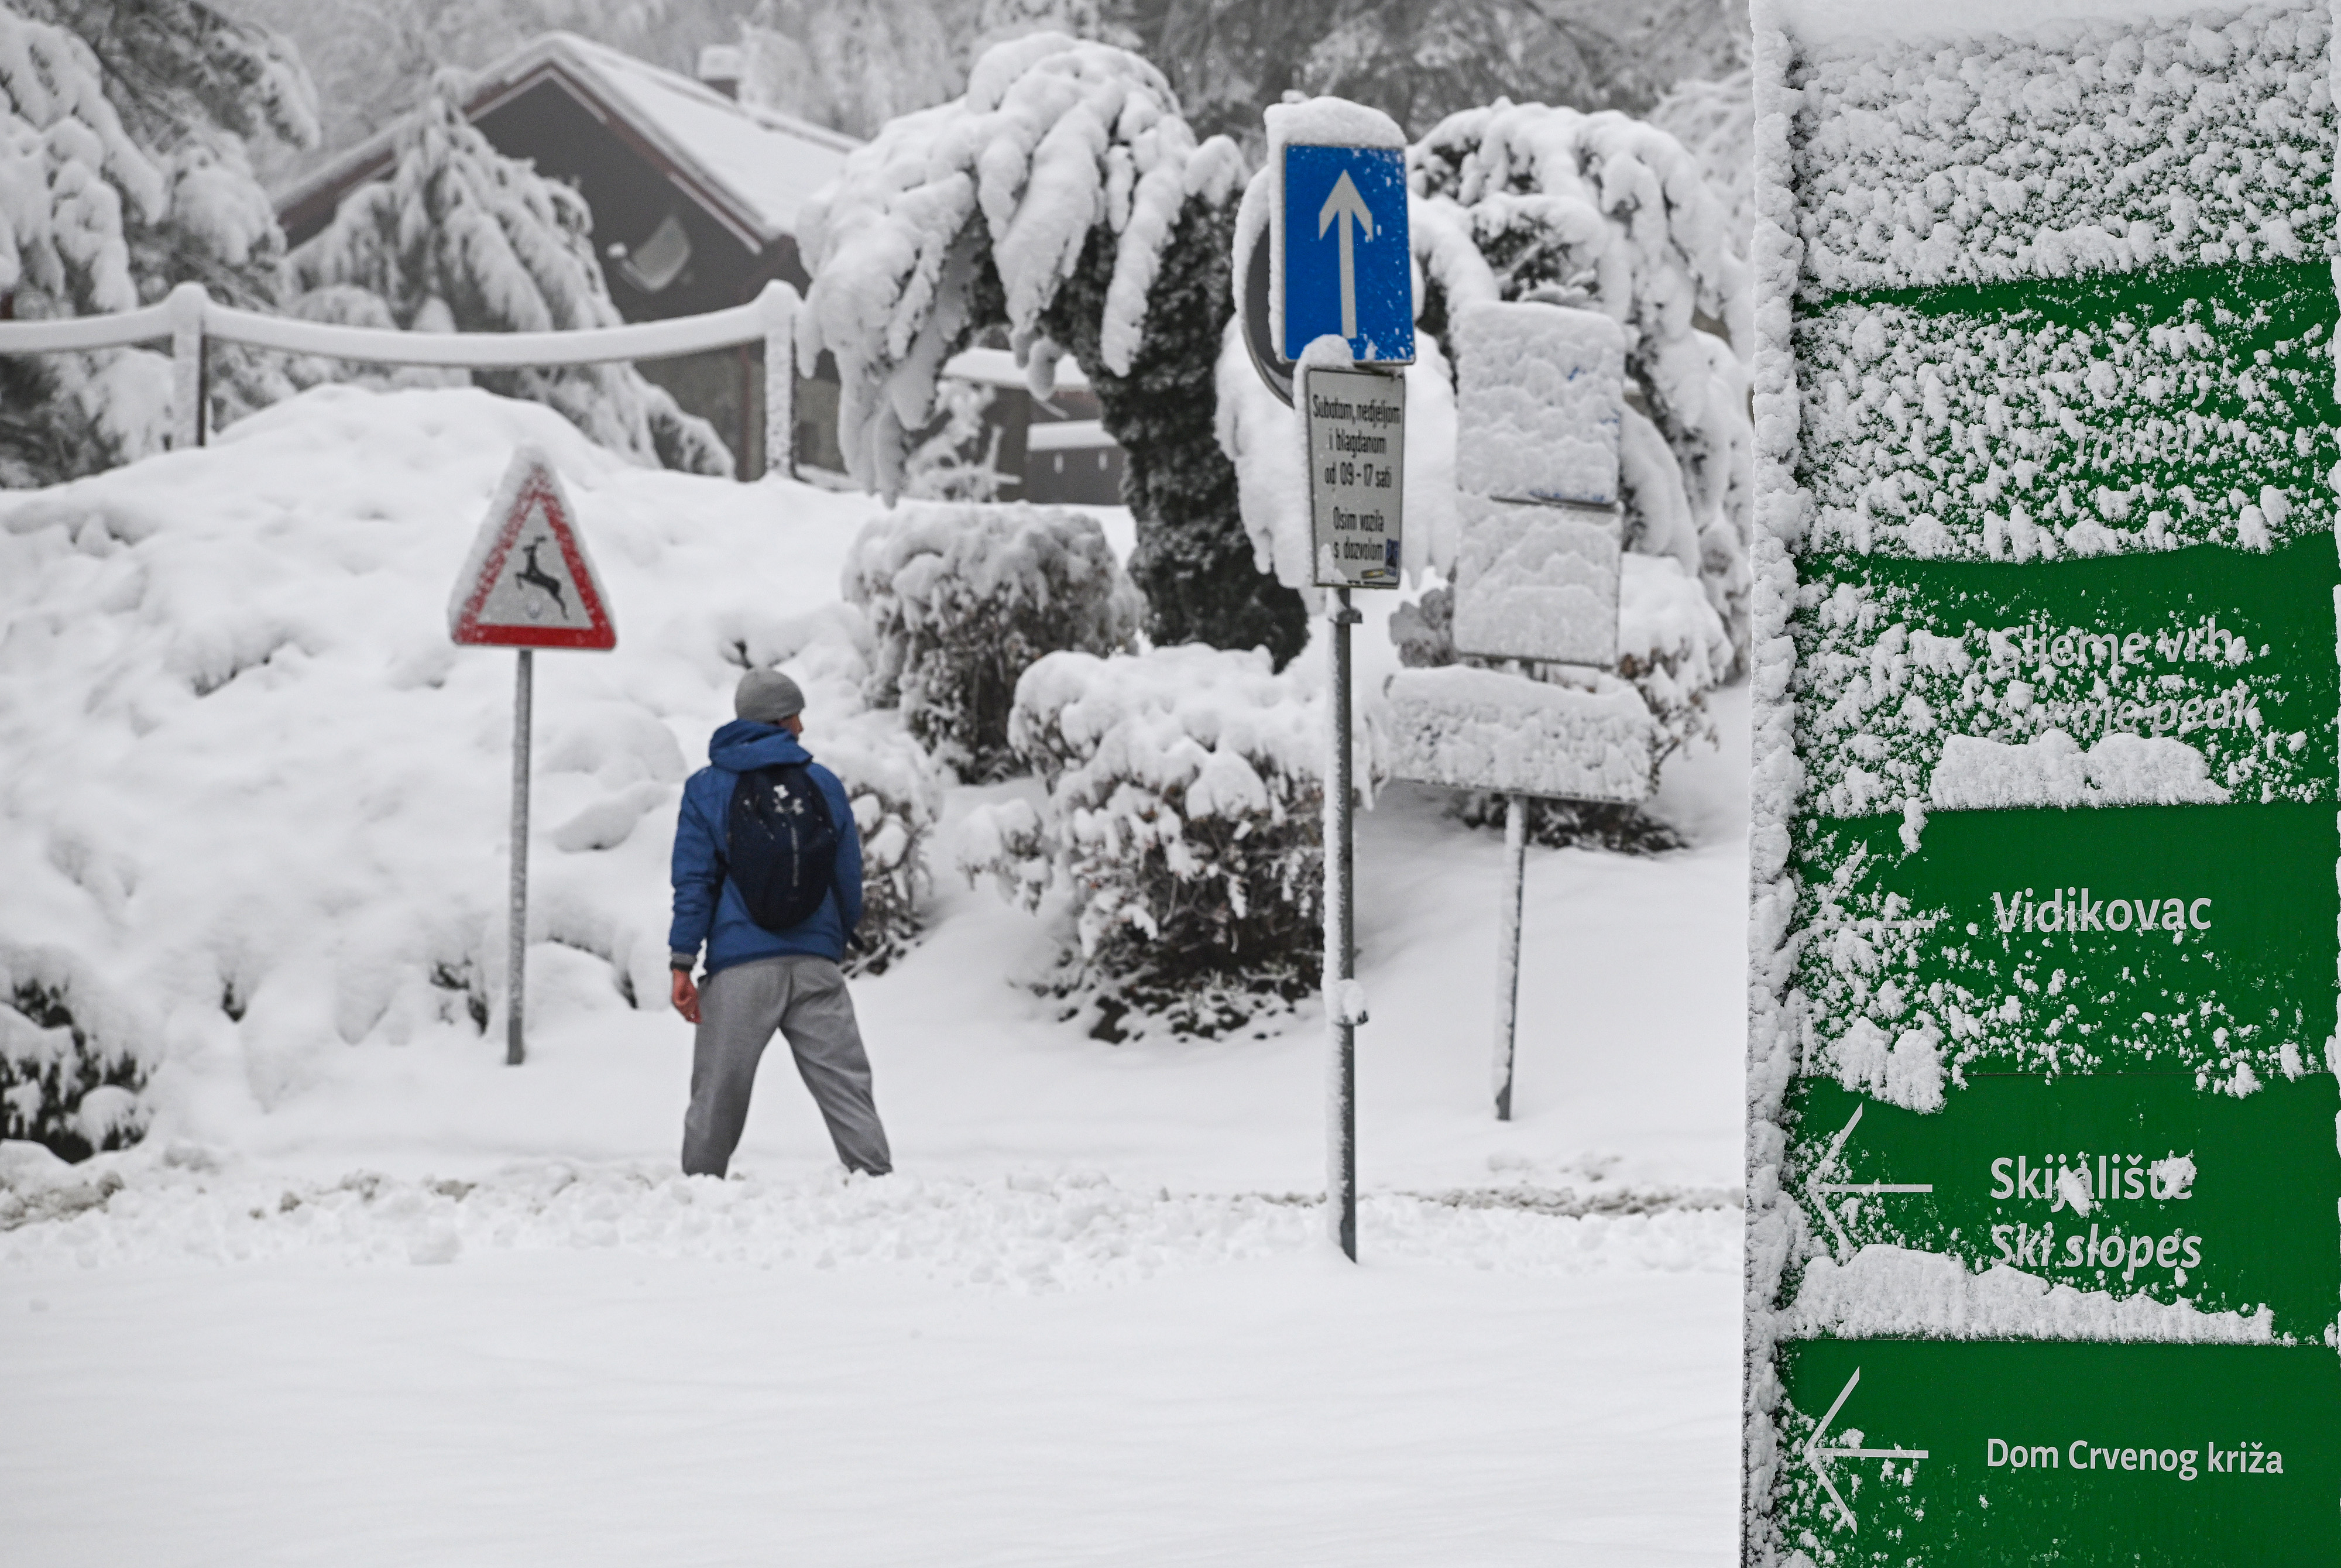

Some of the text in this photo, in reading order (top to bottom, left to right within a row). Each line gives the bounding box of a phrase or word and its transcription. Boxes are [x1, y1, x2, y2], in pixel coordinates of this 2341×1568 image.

[1312, 394, 1401, 429] Subotom, nedjeljom
[1329, 427, 1386, 458] i blagdanom
[1324, 461, 1337, 485] od
[1375, 465, 1392, 488] sati
[1333, 506, 1385, 533] Osim vozila
[1333, 536, 1384, 560] s dozvolom
[1998, 623, 2147, 678] Sljeme
[1992, 887, 2212, 933] Vidikovac
[1989, 1222, 2202, 1281] Ski slopes
[1988, 1438, 2284, 1481] Dom Crvenog križa
